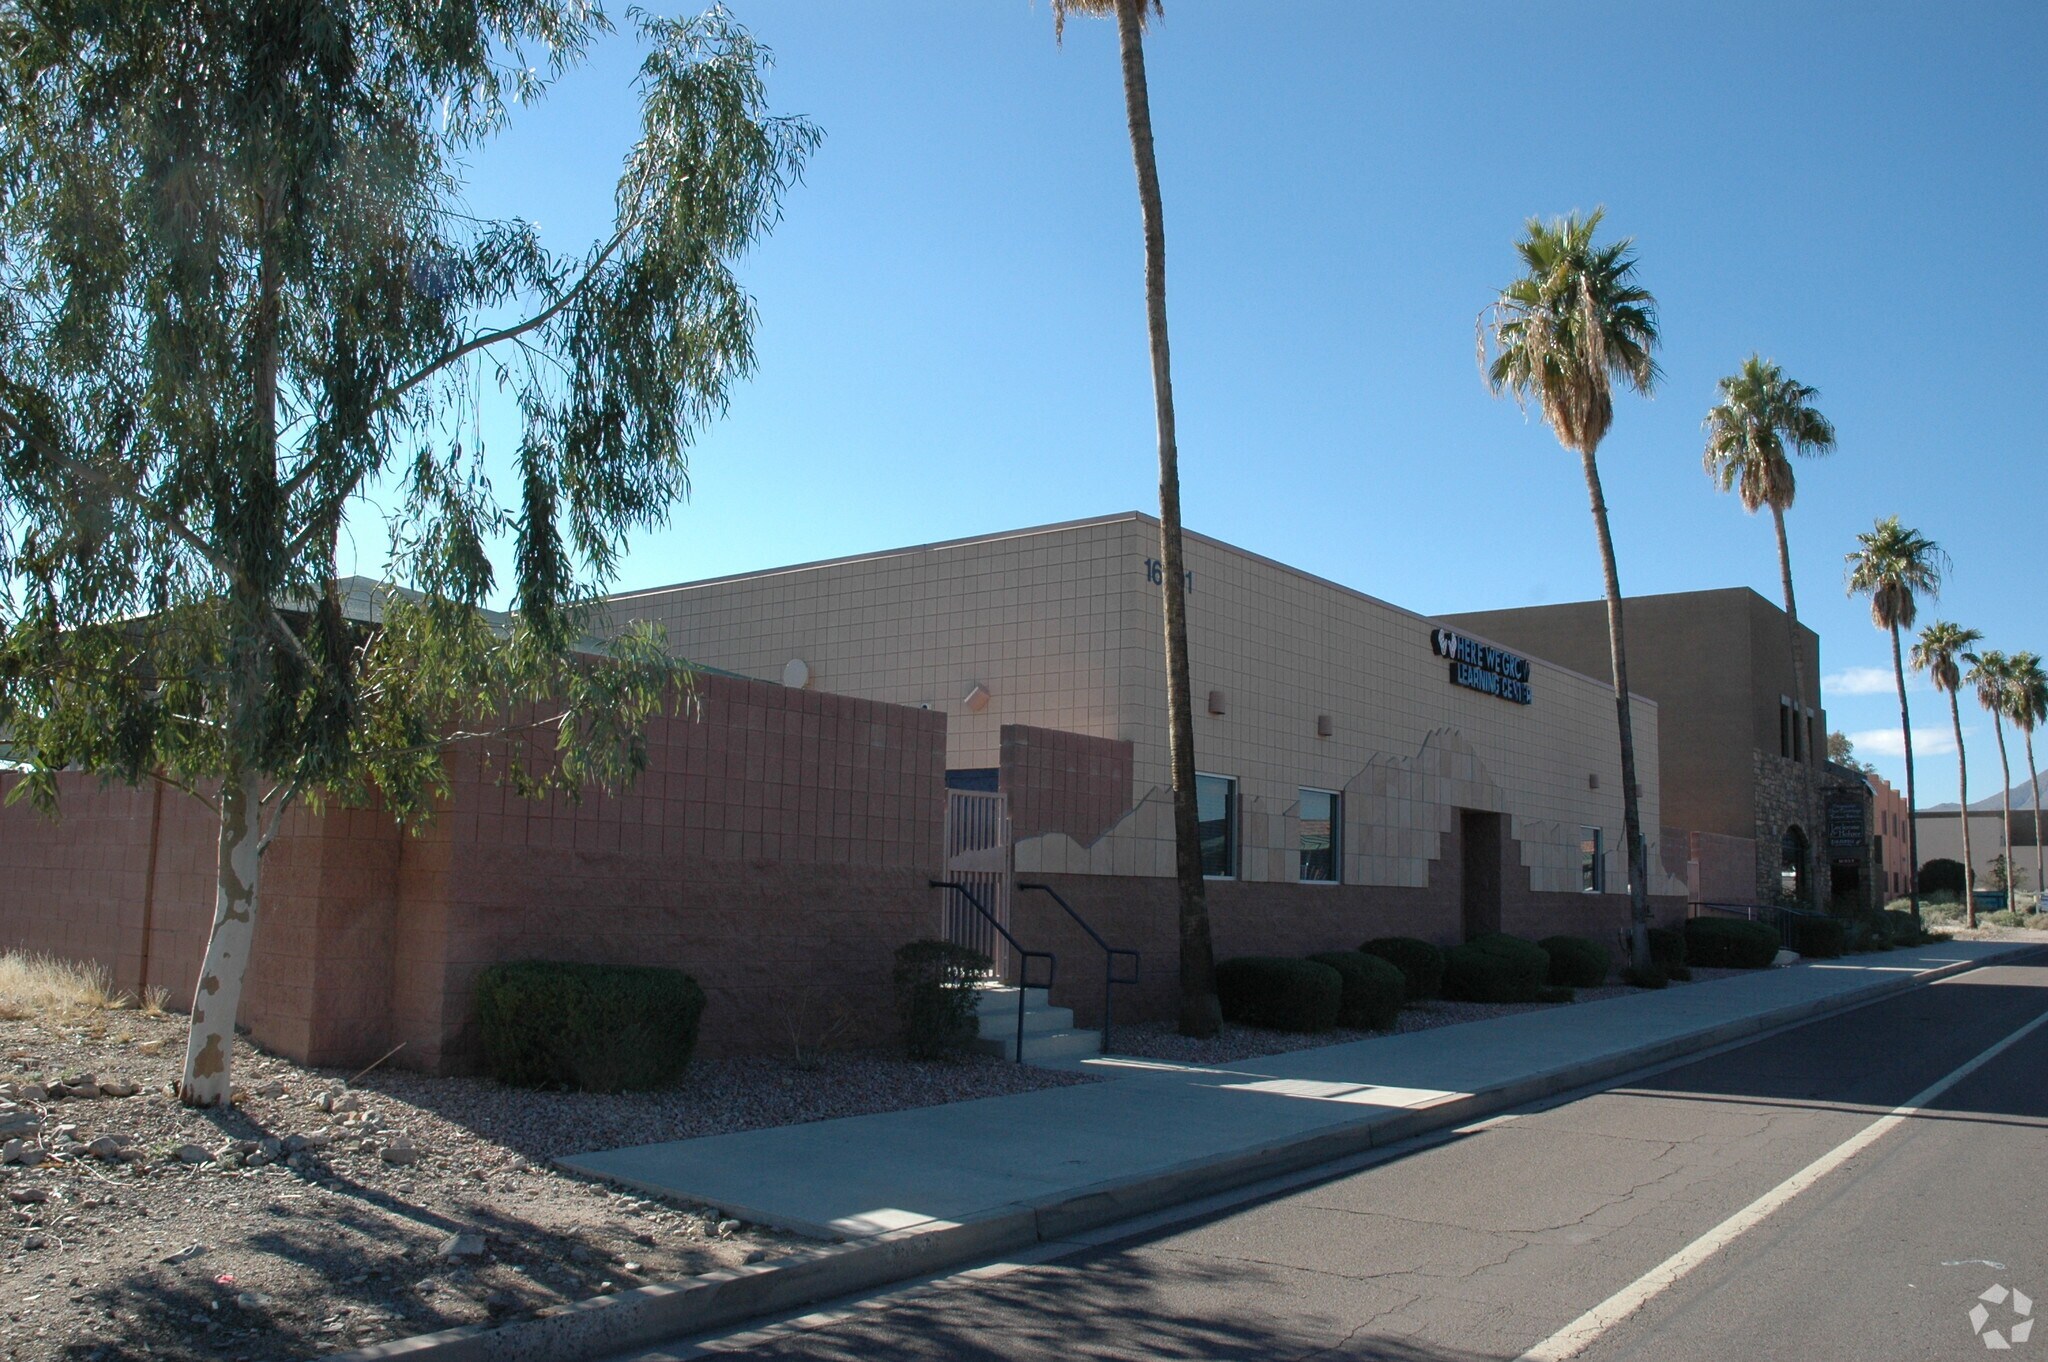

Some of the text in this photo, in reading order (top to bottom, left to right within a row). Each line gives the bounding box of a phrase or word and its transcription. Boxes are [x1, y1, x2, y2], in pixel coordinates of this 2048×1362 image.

[1438, 629, 1484, 667] WHERE
[1486, 645, 1501, 673] WE
[1457, 661, 1532, 704] LEARNING CENTER
